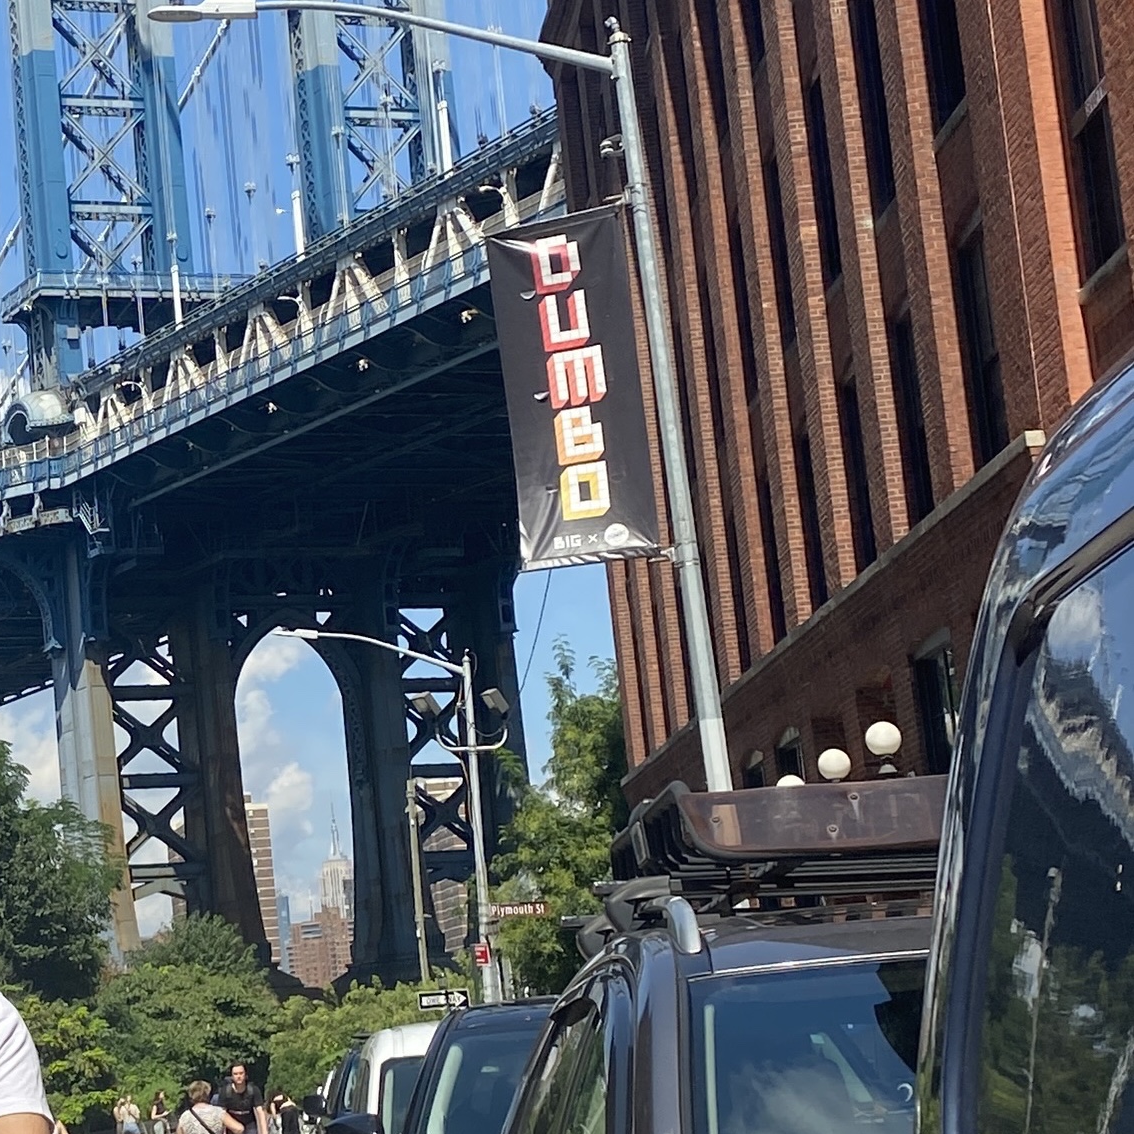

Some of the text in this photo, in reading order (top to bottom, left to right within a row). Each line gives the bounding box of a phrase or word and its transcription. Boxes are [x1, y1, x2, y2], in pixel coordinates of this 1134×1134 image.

[531, 233, 611, 521] DUMBO
[553, 534, 582, 550] BIG
[491, 903, 545, 917] Plymouth St
